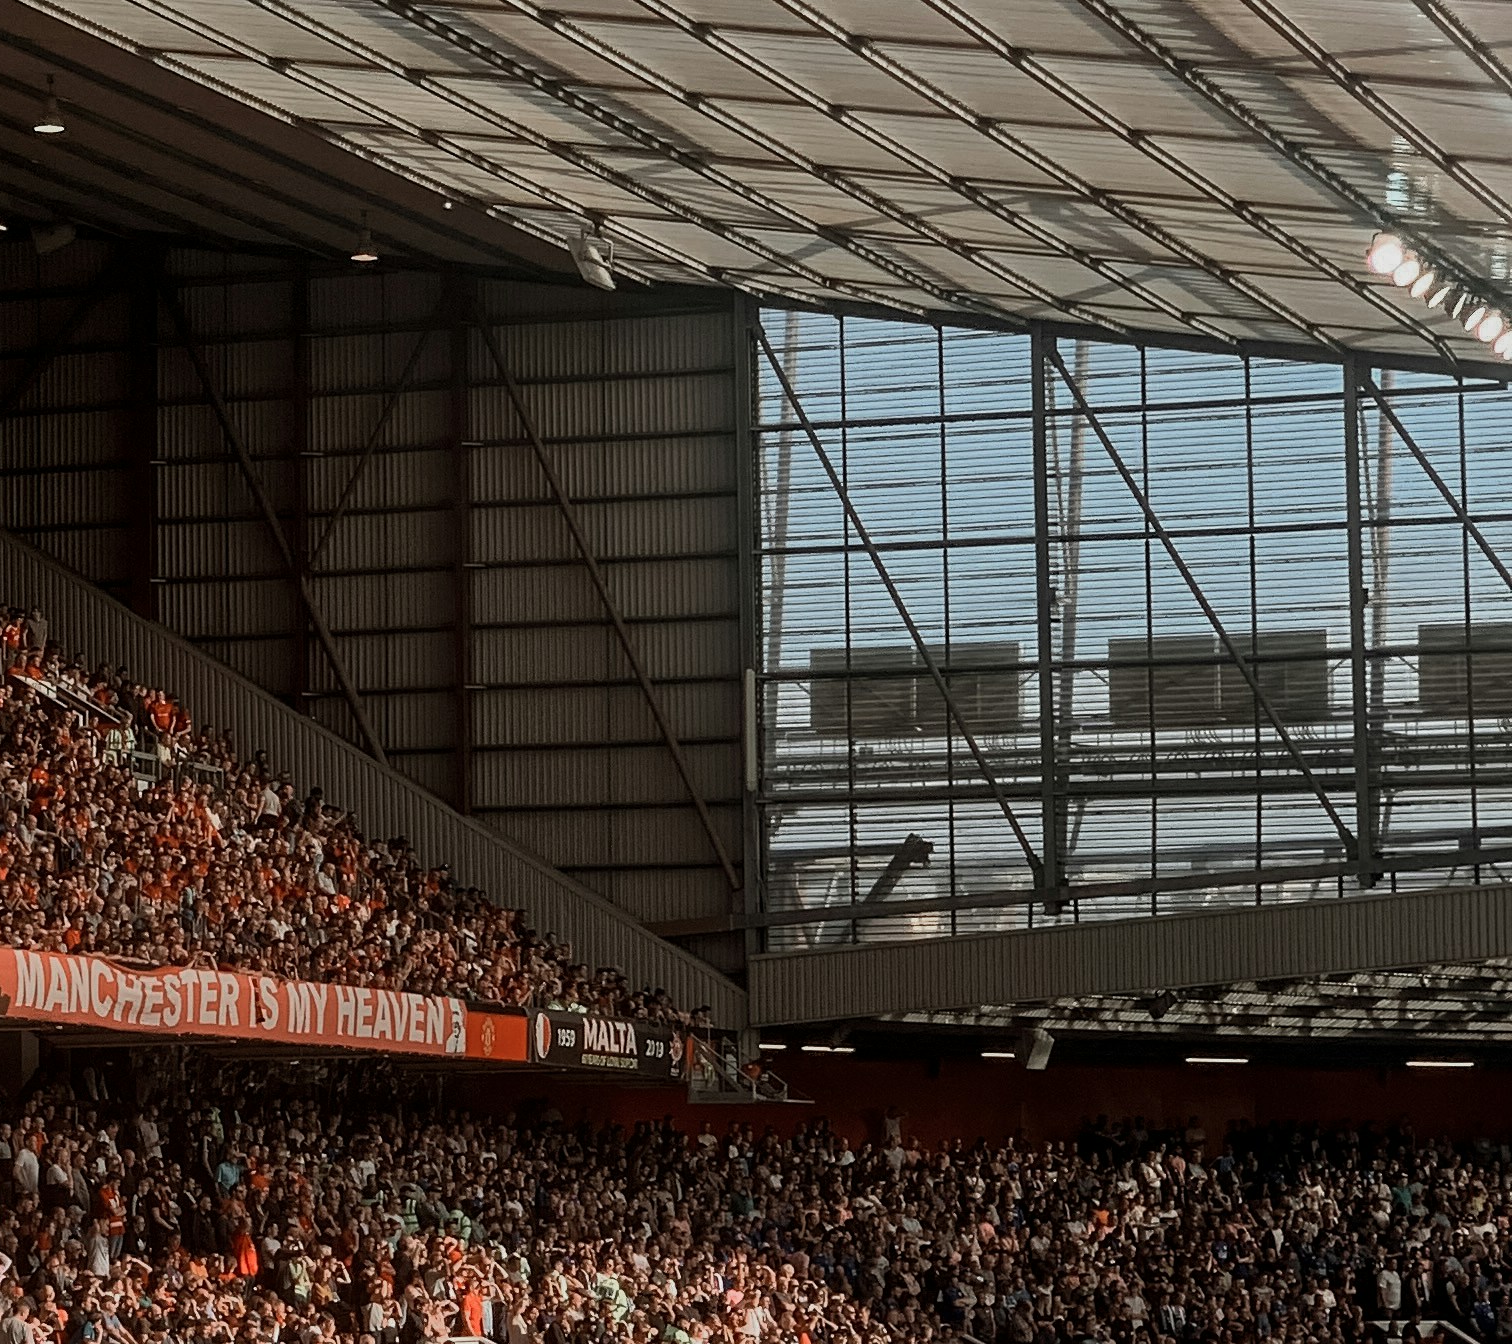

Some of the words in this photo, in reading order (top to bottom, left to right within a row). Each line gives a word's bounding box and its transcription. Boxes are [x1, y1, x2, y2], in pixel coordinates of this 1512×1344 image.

[14, 949, 240, 1029] MANCHESTER
[249, 976, 279, 1031] IS
[286, 981, 328, 1035] MY
[334, 984, 445, 1045] HEAVEN
[557, 1028, 576, 1047] 1959
[582, 1017, 637, 1055] MALTA
